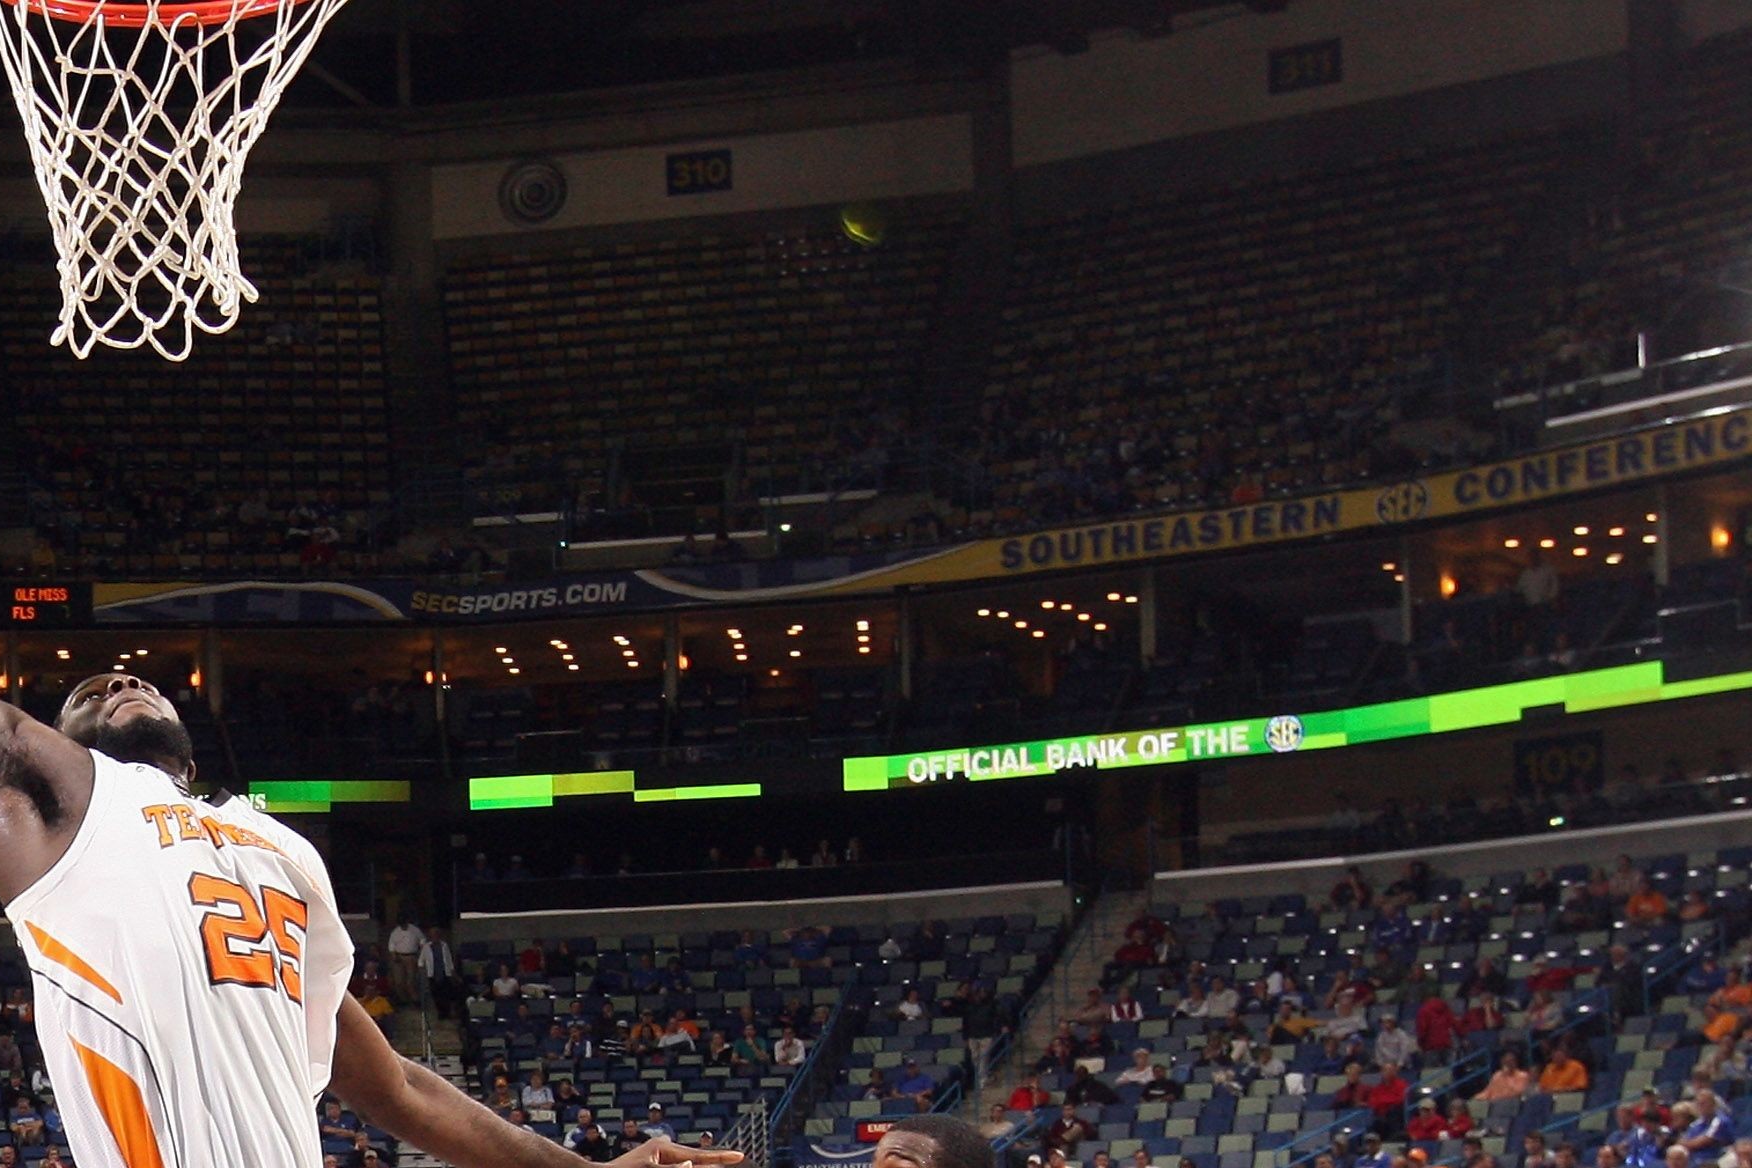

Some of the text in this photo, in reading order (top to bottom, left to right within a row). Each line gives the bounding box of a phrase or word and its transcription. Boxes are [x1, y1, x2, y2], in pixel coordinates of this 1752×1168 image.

[673, 158, 729, 188] 310
[1001, 500, 1340, 570] SOUTHEASTERN
[15, 588, 67, 601] OLE MISS
[411, 582, 627, 614] SECSPORTS.COM
[12, 606, 34, 619] FLS
[908, 746, 1035, 783] OFFICIAL
[1047, 738, 1126, 771] BANK
[1137, 732, 1179, 759] OF
[1186, 725, 1250, 755] THE
[187, 870, 308, 1009] 25
